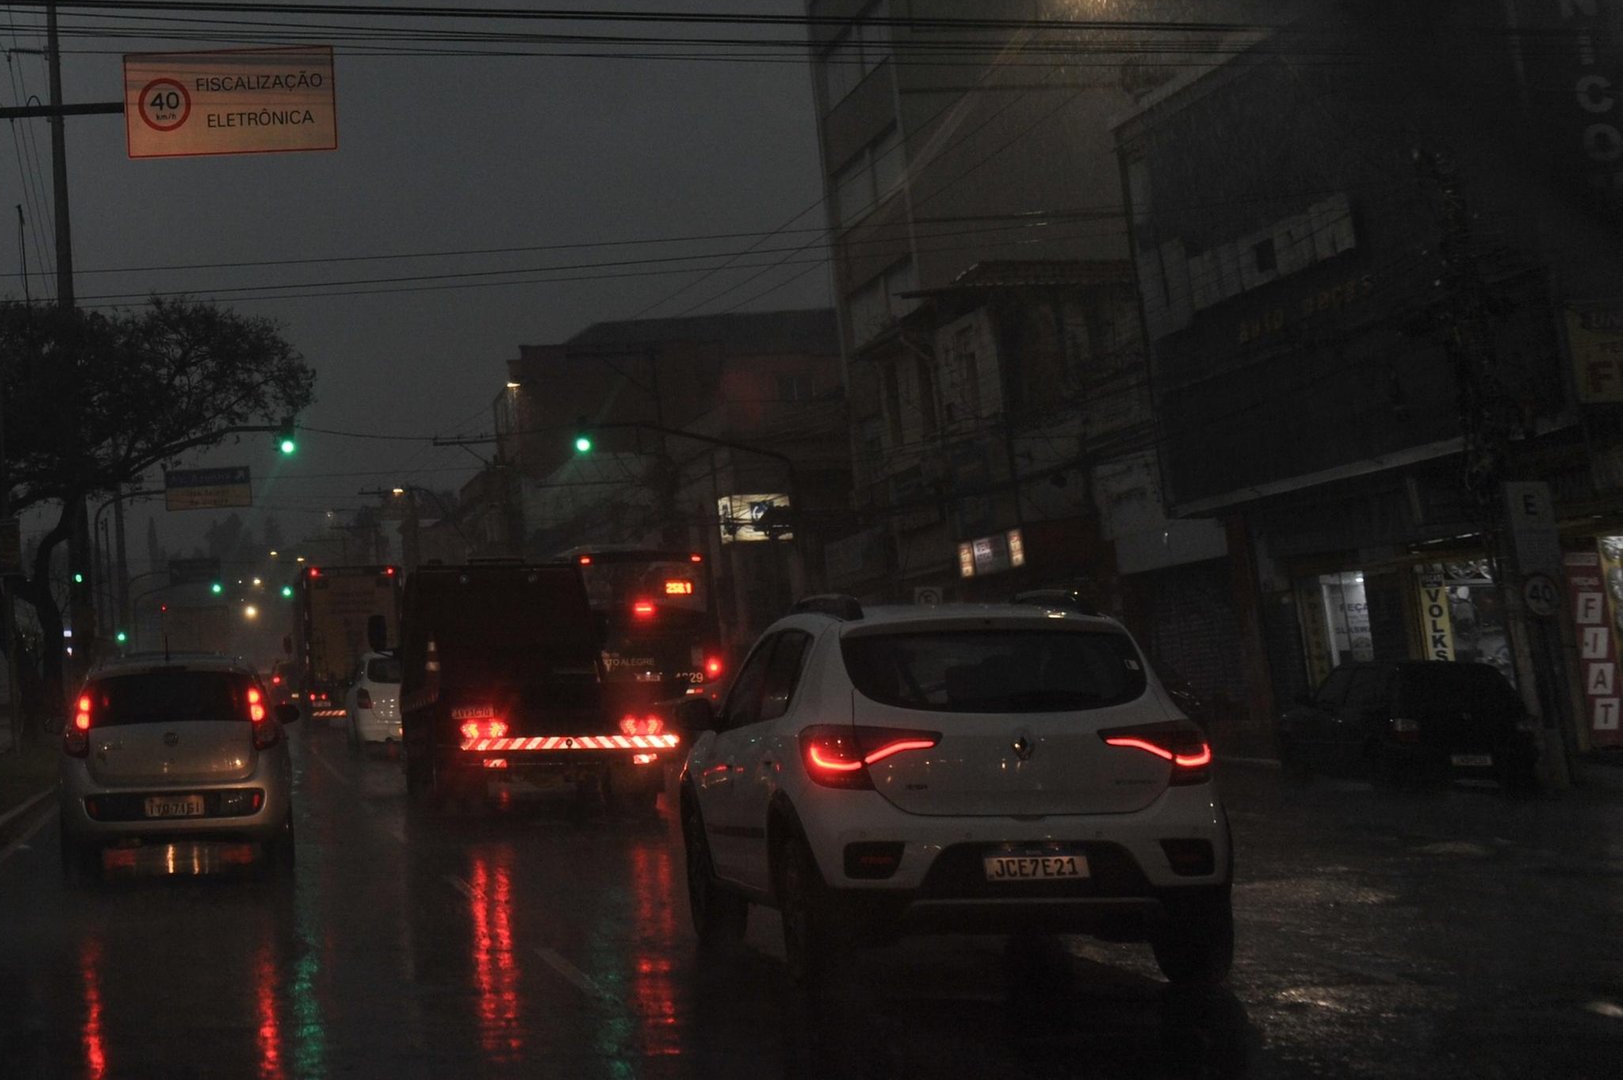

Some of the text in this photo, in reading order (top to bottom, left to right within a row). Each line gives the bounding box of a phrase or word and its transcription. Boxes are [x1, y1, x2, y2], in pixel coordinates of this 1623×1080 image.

[196, 70, 324, 92] FISCALIZAÇÃO
[150, 91, 180, 111] 40
[156, 113, 177, 121] km/h
[207, 108, 315, 128] ELETRÔNICA
[1528, 584, 1553, 603] 40
[621, 658, 655, 666] ALEGRE
[1584, 597, 1614, 719] FIAT
[995, 858, 1079, 877] JCE7E21
